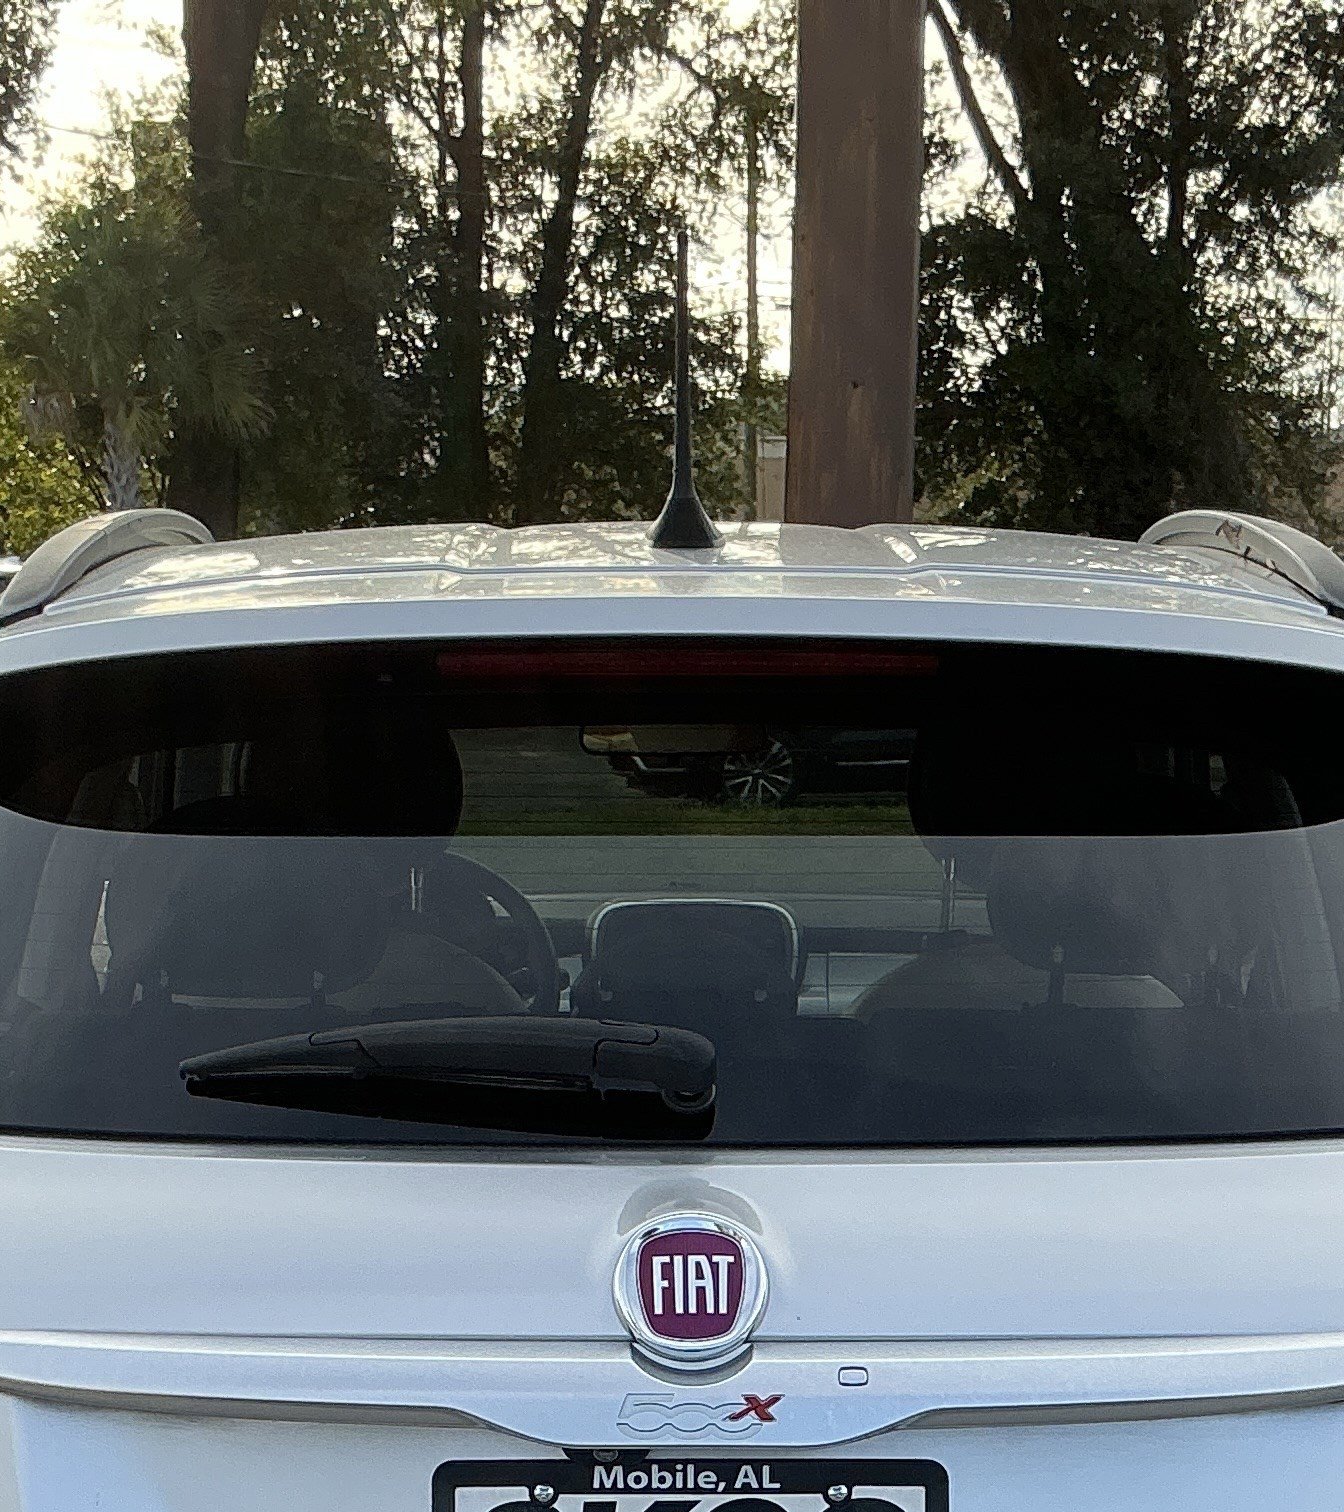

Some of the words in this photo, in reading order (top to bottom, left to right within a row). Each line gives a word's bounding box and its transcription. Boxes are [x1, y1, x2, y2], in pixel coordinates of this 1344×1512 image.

[650, 1254, 736, 1316] FIAT
[592, 1463, 727, 1493] Mobile,
[733, 1464, 782, 1489] AL
